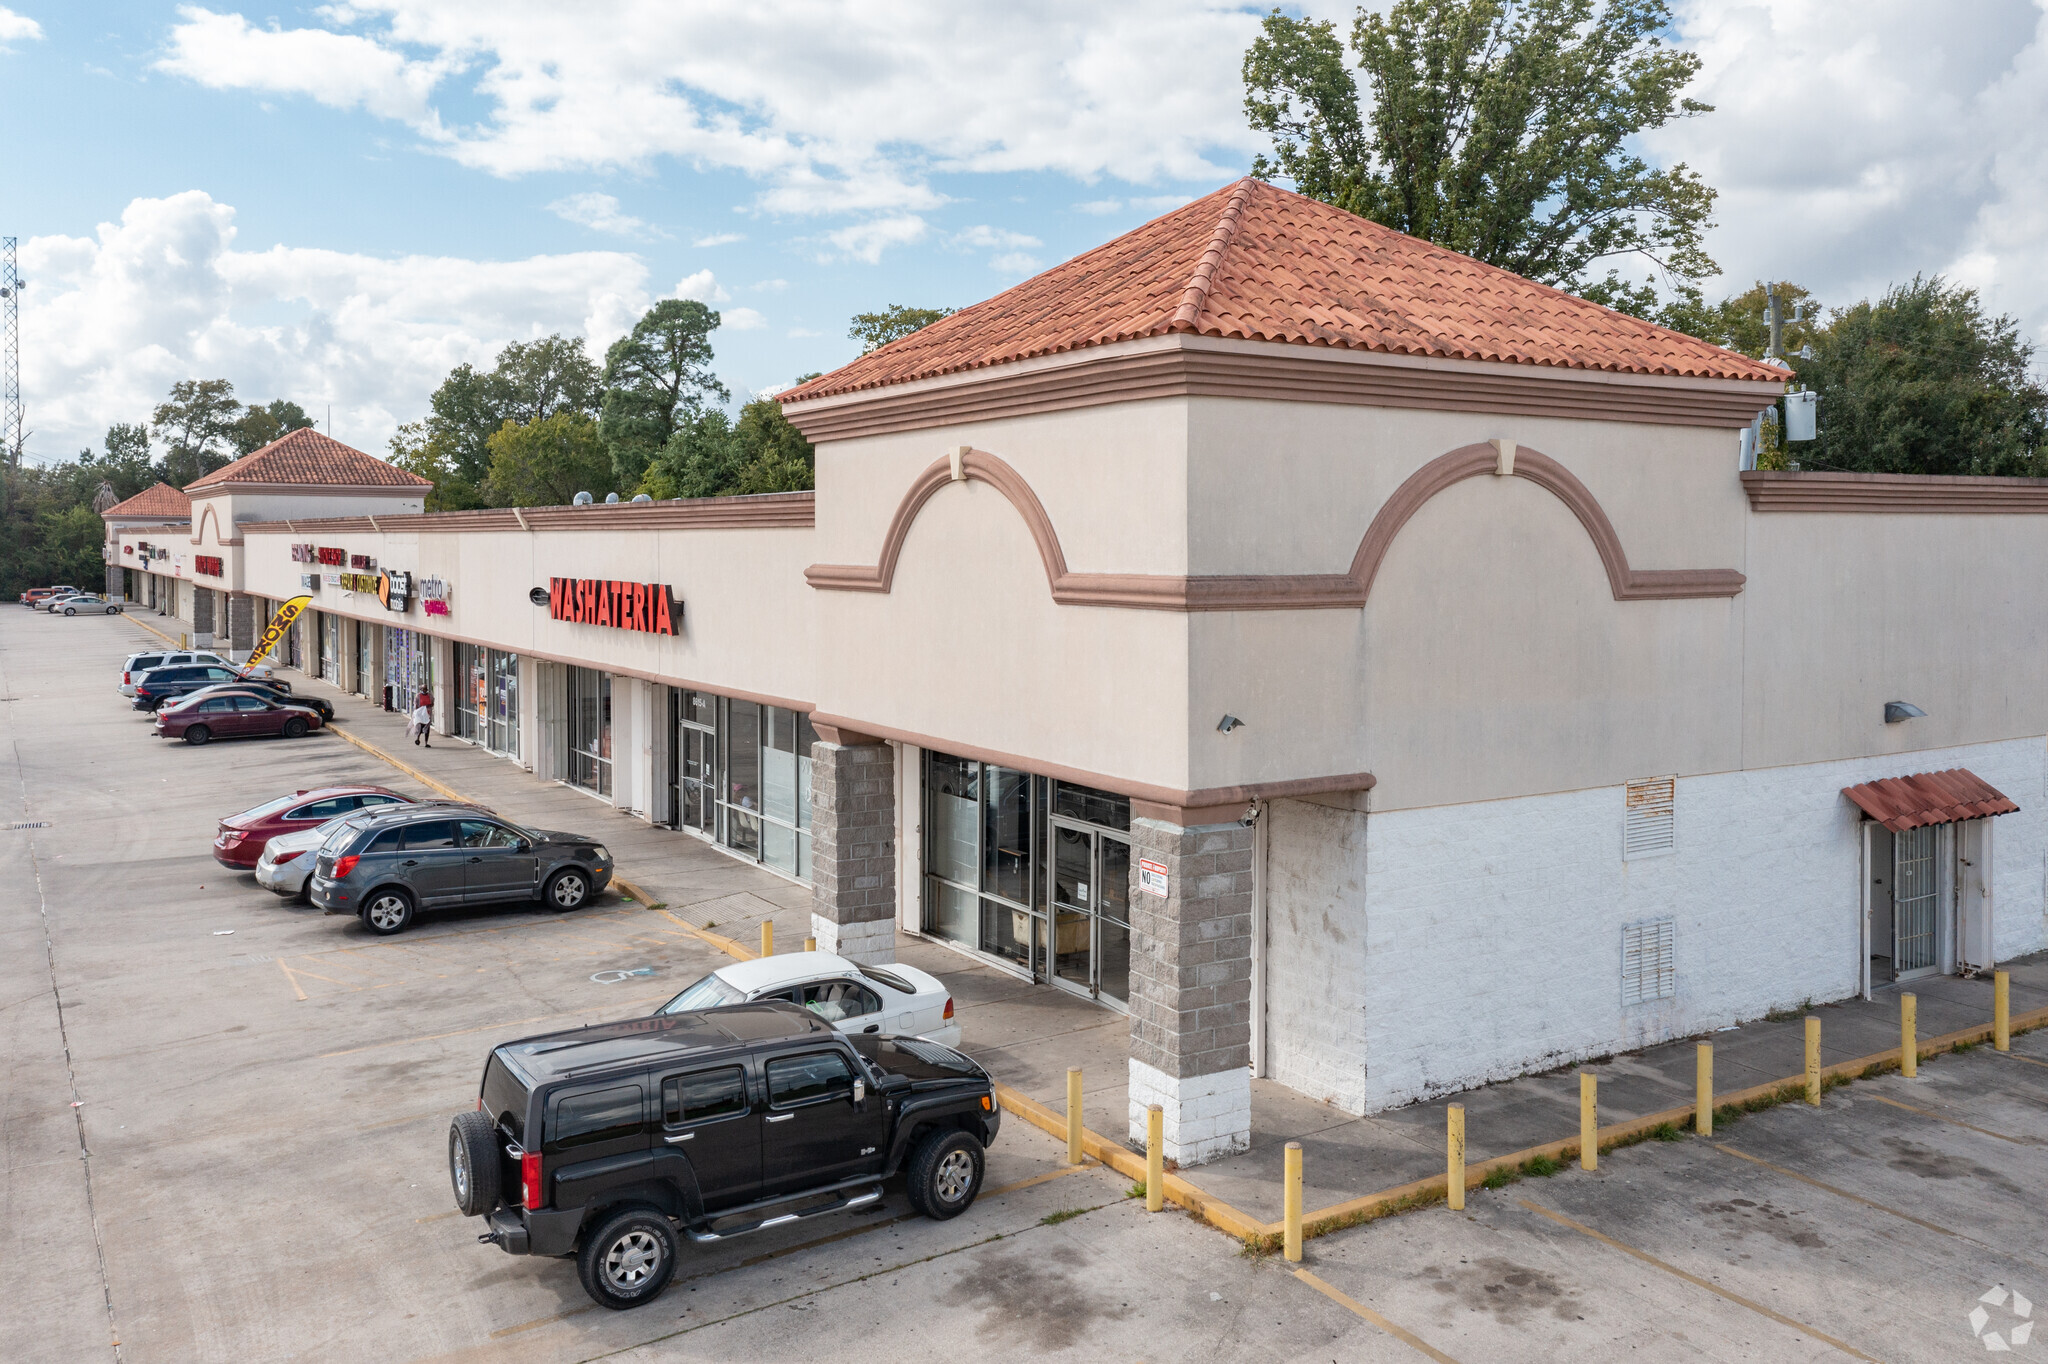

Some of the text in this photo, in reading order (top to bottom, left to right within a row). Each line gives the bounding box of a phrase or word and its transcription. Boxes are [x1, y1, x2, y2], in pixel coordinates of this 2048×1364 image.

[420, 574, 443, 600] metro
[550, 577, 674, 637] WASHATERIA
[247, 604, 299, 665] SMOKE
[1142, 870, 1151, 885] NO
